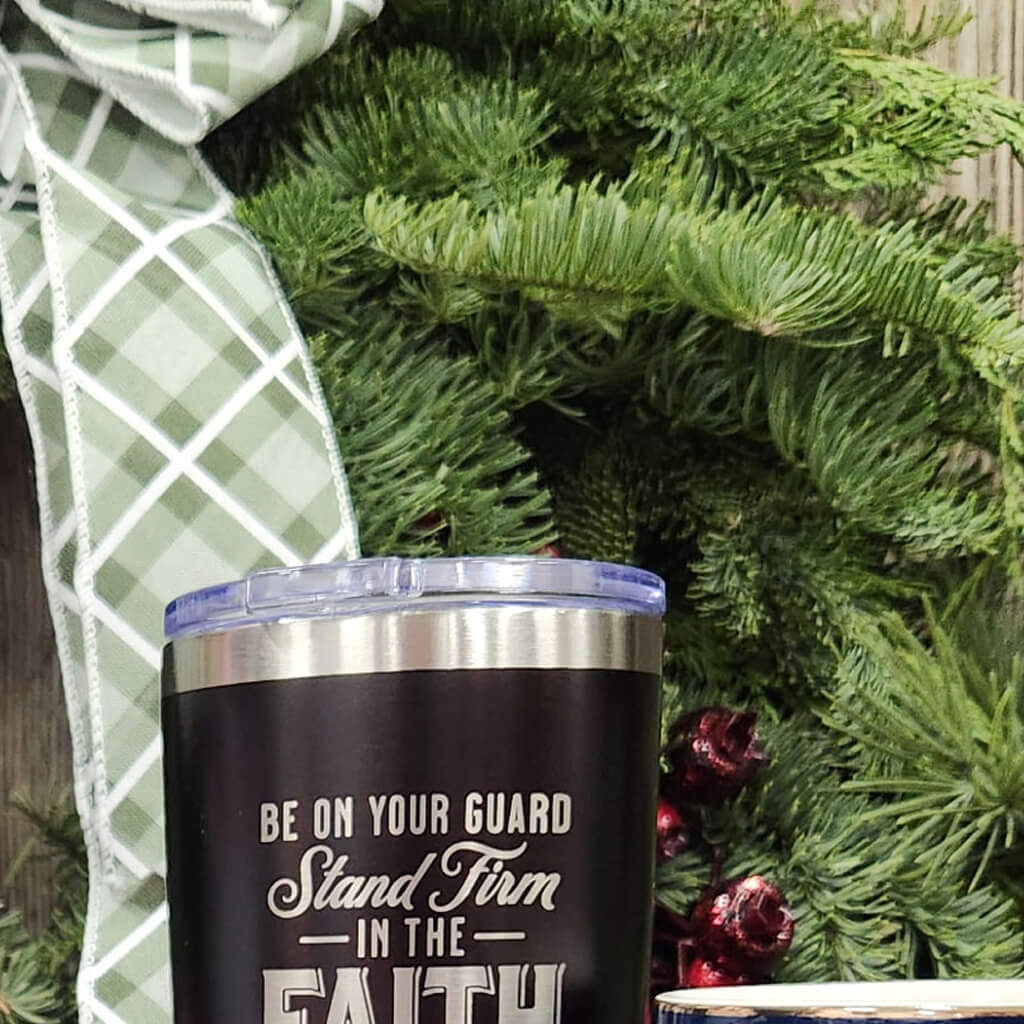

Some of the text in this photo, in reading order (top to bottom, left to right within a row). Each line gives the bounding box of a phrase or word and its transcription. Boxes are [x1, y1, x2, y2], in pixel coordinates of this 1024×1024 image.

[260, 791, 572, 843] BE ON YOUR GUARD
[267, 841, 562, 920] Stand Firm
[357, 915, 466, 959] IN THE
